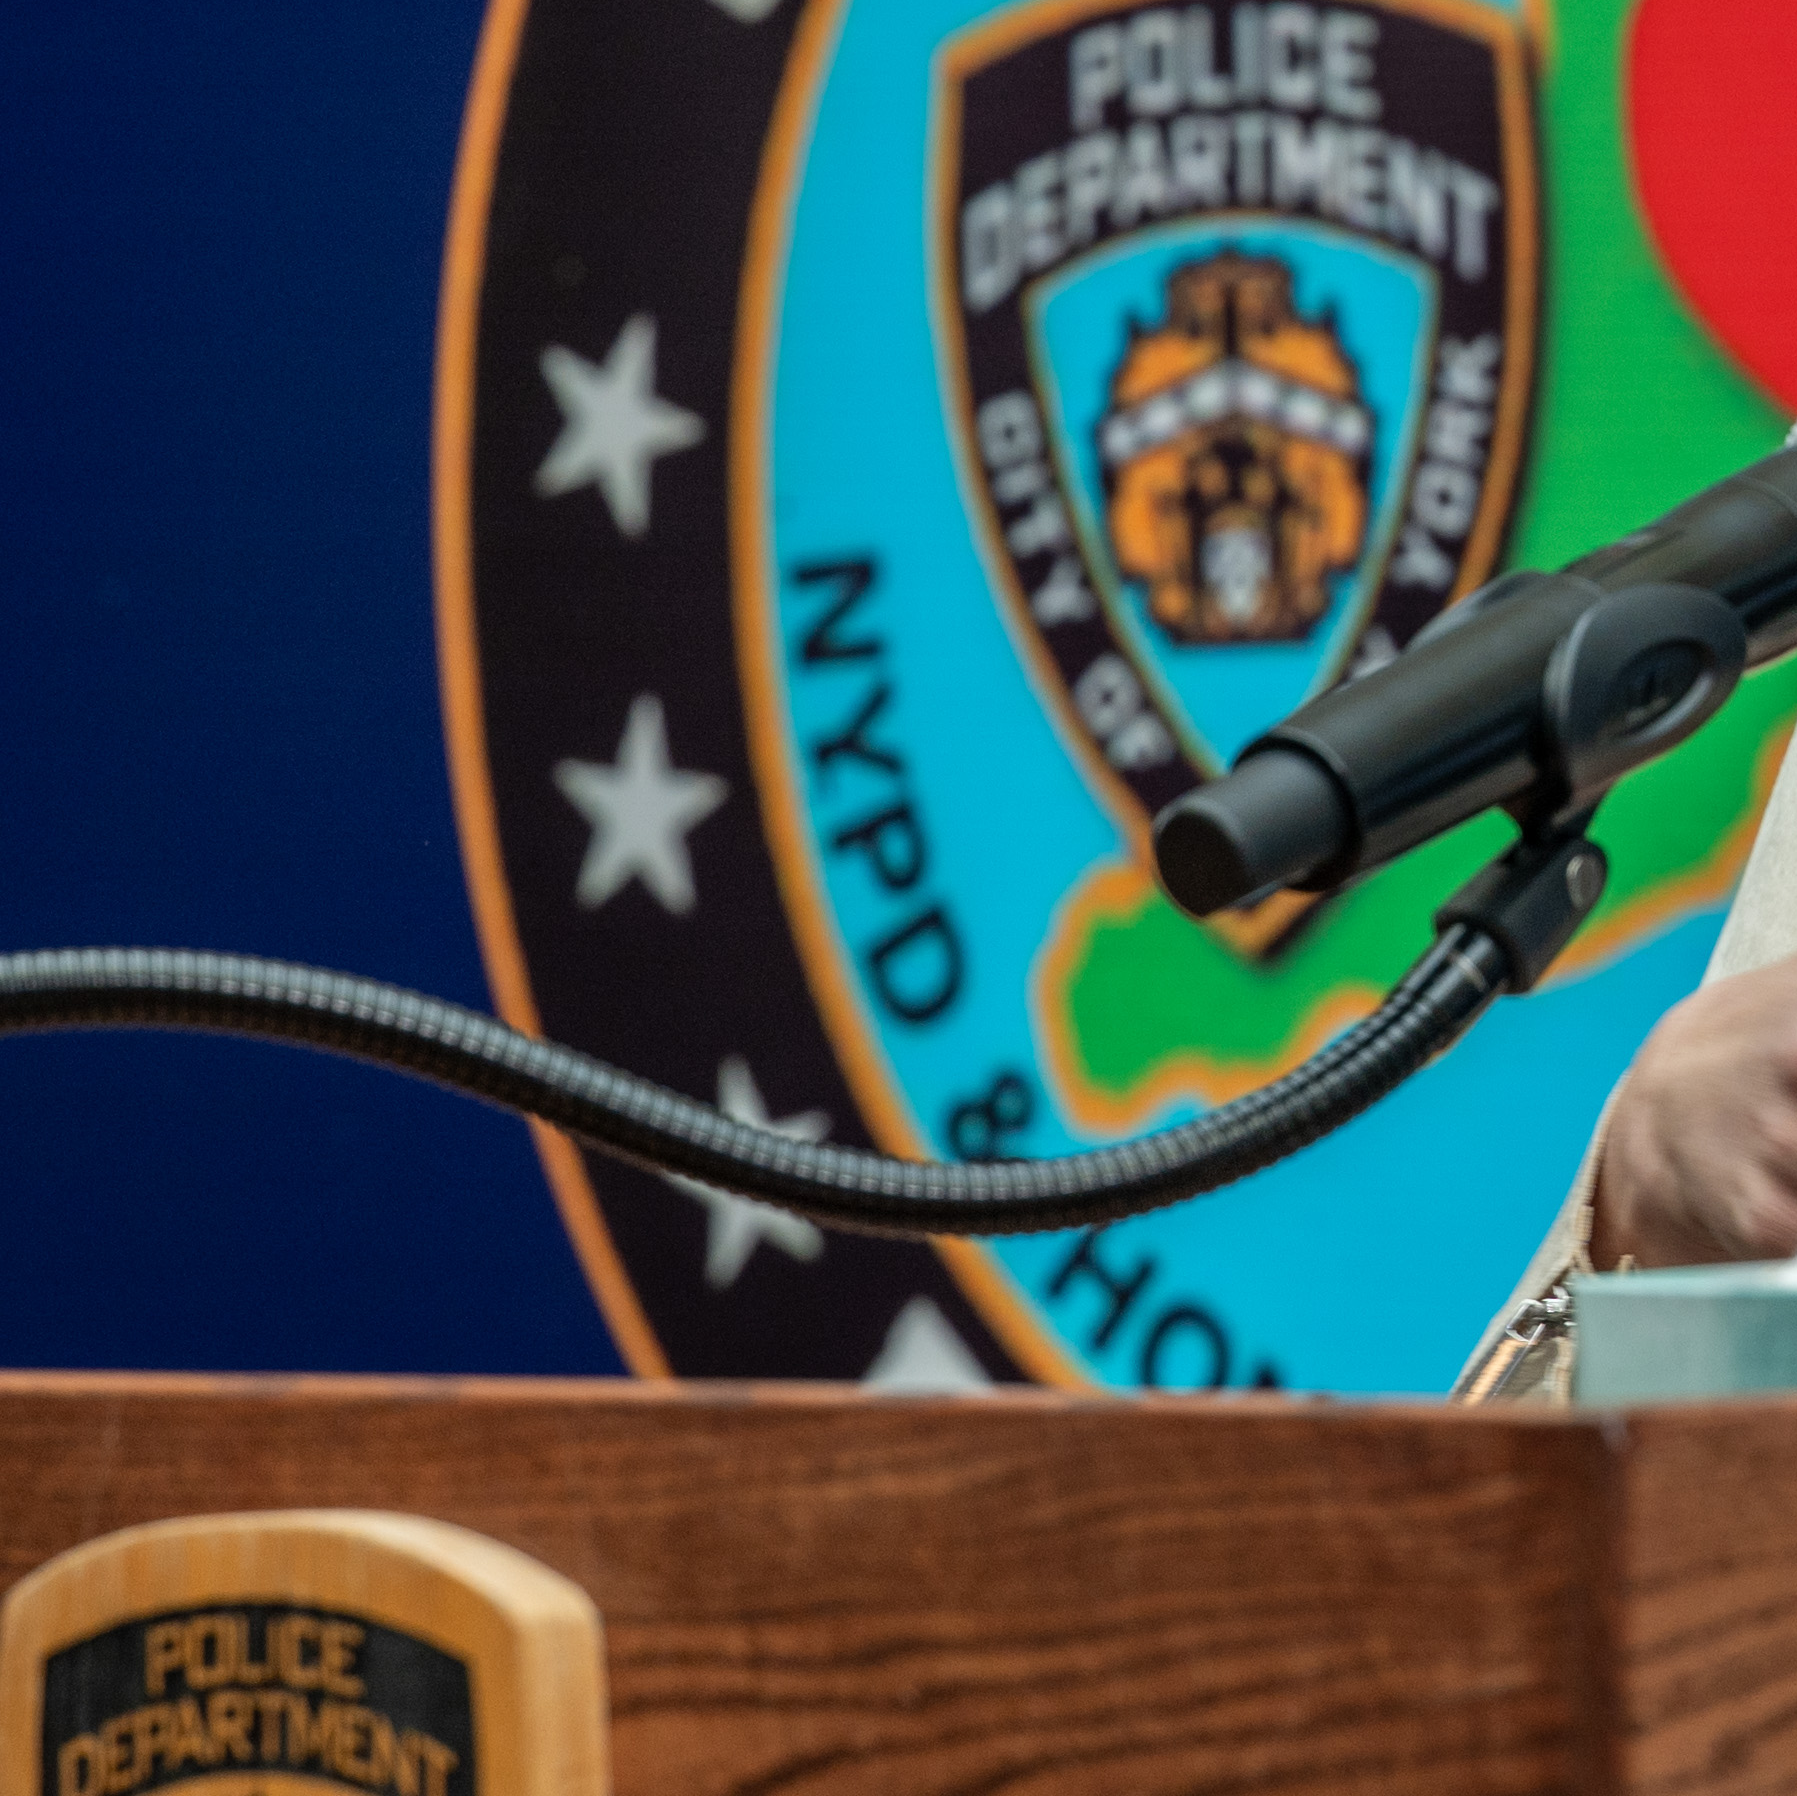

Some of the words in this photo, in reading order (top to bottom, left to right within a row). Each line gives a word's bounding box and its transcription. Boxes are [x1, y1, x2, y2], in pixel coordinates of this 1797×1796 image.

[1069, 3, 1384, 131] POLICE
[962, 111, 1498, 312] DEPARTMENT
[1390, 332, 1499, 591] YORK
[791, 550, 968, 1034] NYPD
[1045, 1226, 1286, 1392] HO
[144, 1612, 366, 1698] POLICE
[57, 1691, 458, 1796] DEPARTMENT
